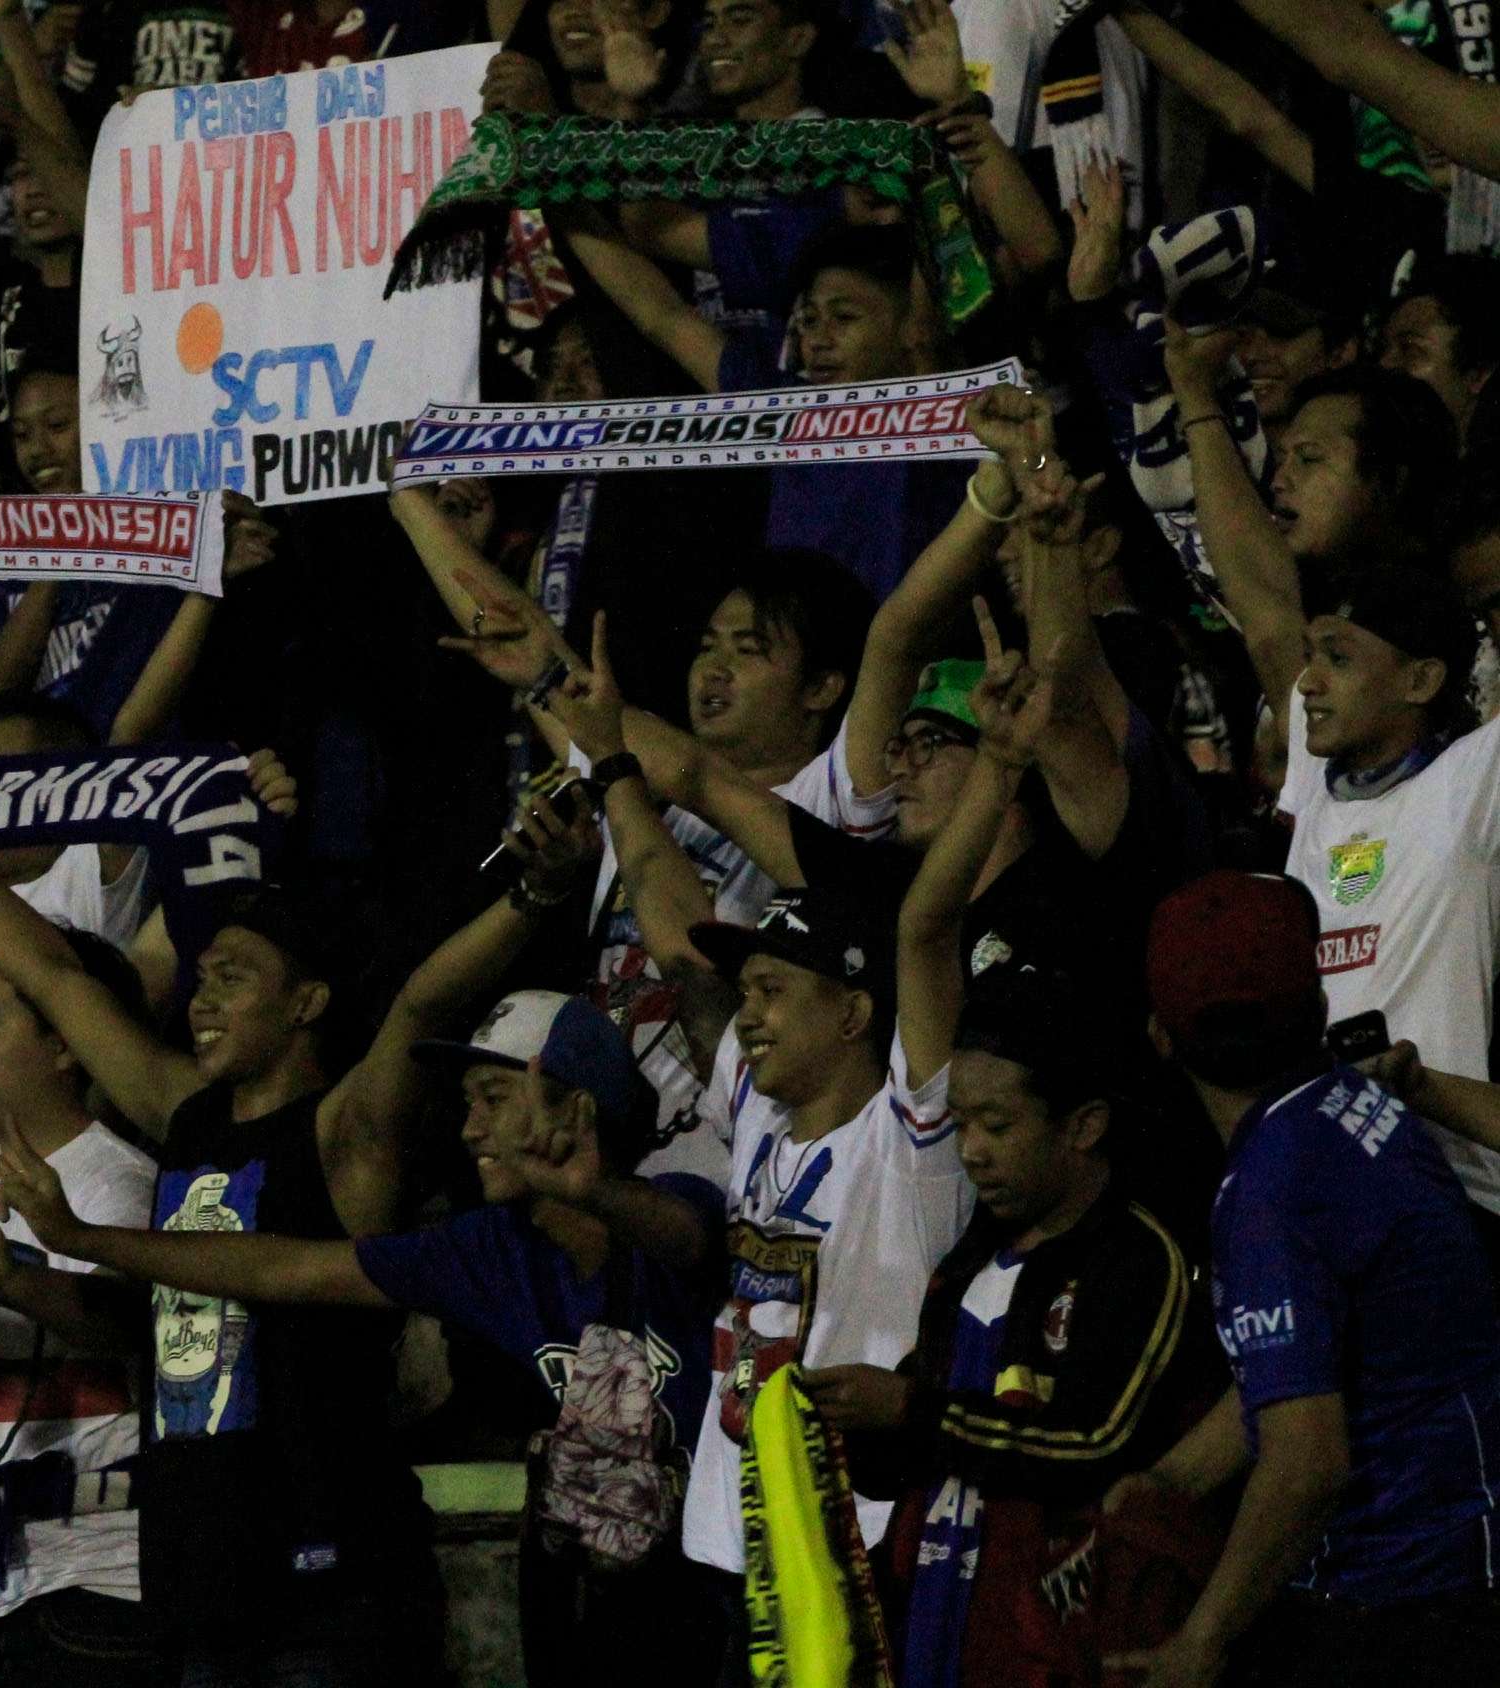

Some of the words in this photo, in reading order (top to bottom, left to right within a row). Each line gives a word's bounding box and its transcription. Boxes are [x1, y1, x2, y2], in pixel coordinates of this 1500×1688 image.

[174, 75, 288, 141] PERSIB
[317, 64, 387, 125] DAY
[120, 132, 301, 294] HATUR
[212, 340, 375, 427] SCTV
[426, 407, 612, 422] SUPPORTER
[643, 395, 781, 415] PERSIB
[816, 370, 1010, 404] BANDUNG
[410, 422, 603, 453] VIKING
[603, 413, 798, 447] FARMASI
[785, 398, 967, 443] INDONESI
[90, 425, 247, 495] VIKING
[592, 450, 766, 468] TANDANG
[5, 555, 192, 576] MANGPRANG
